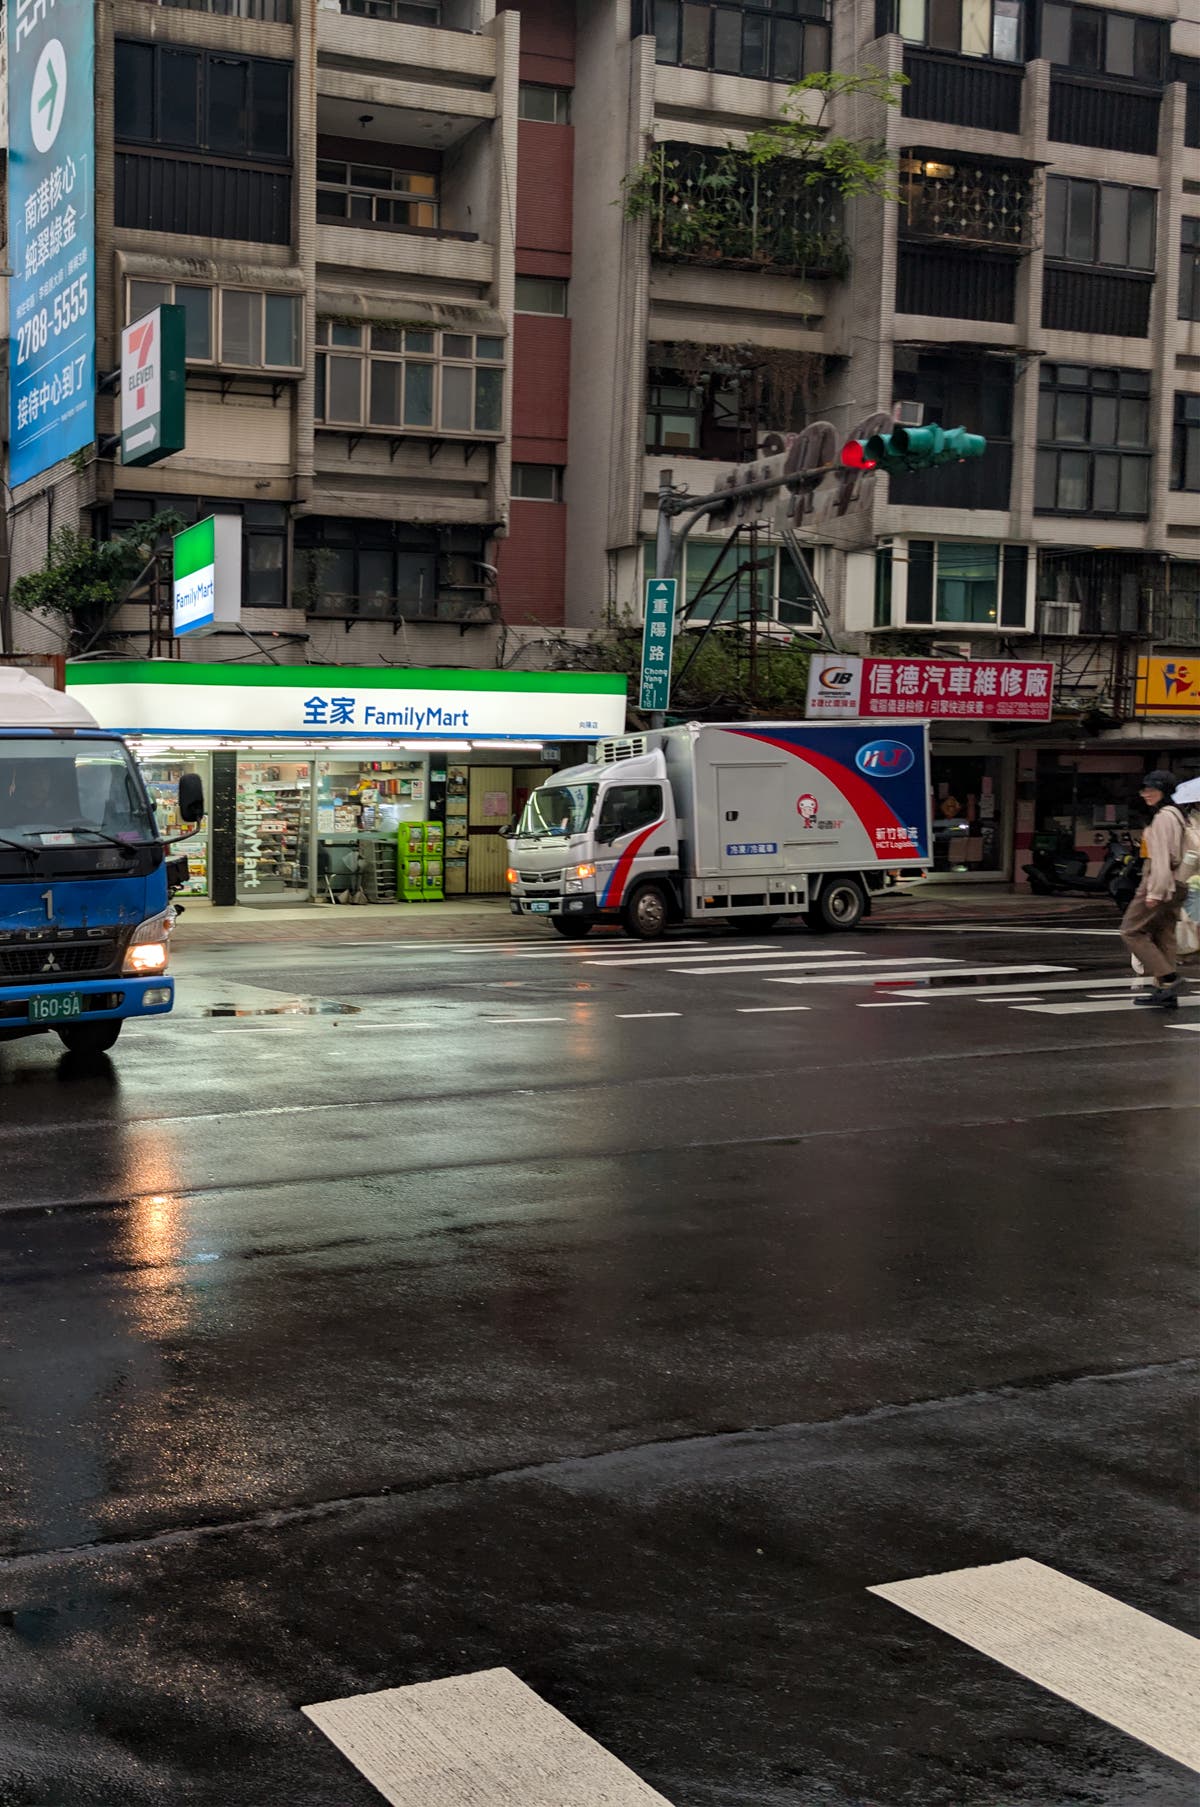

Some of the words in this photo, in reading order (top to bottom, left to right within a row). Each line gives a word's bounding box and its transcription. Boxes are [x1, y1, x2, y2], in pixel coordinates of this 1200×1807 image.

[25, 155, 76, 234] 南港核心
[17, 273, 88, 366] 2788-5555
[17, 353, 87, 430] 接待中心到了
[176, 580, 213, 610] FamilyMart
[649, 598, 668, 661] 重陽路
[644, 667, 668, 677] Chong
[644, 675, 662, 684] Yang
[869, 664, 1049, 697] 信德汽車維修廠
[303, 696, 355, 725] 全家
[364, 706, 469, 730] FamilyMart
[244, 770, 263, 888] FamilyMart
[875, 826, 919, 840] 新竹物流
[33, 997, 81, 1018] 160-9A
